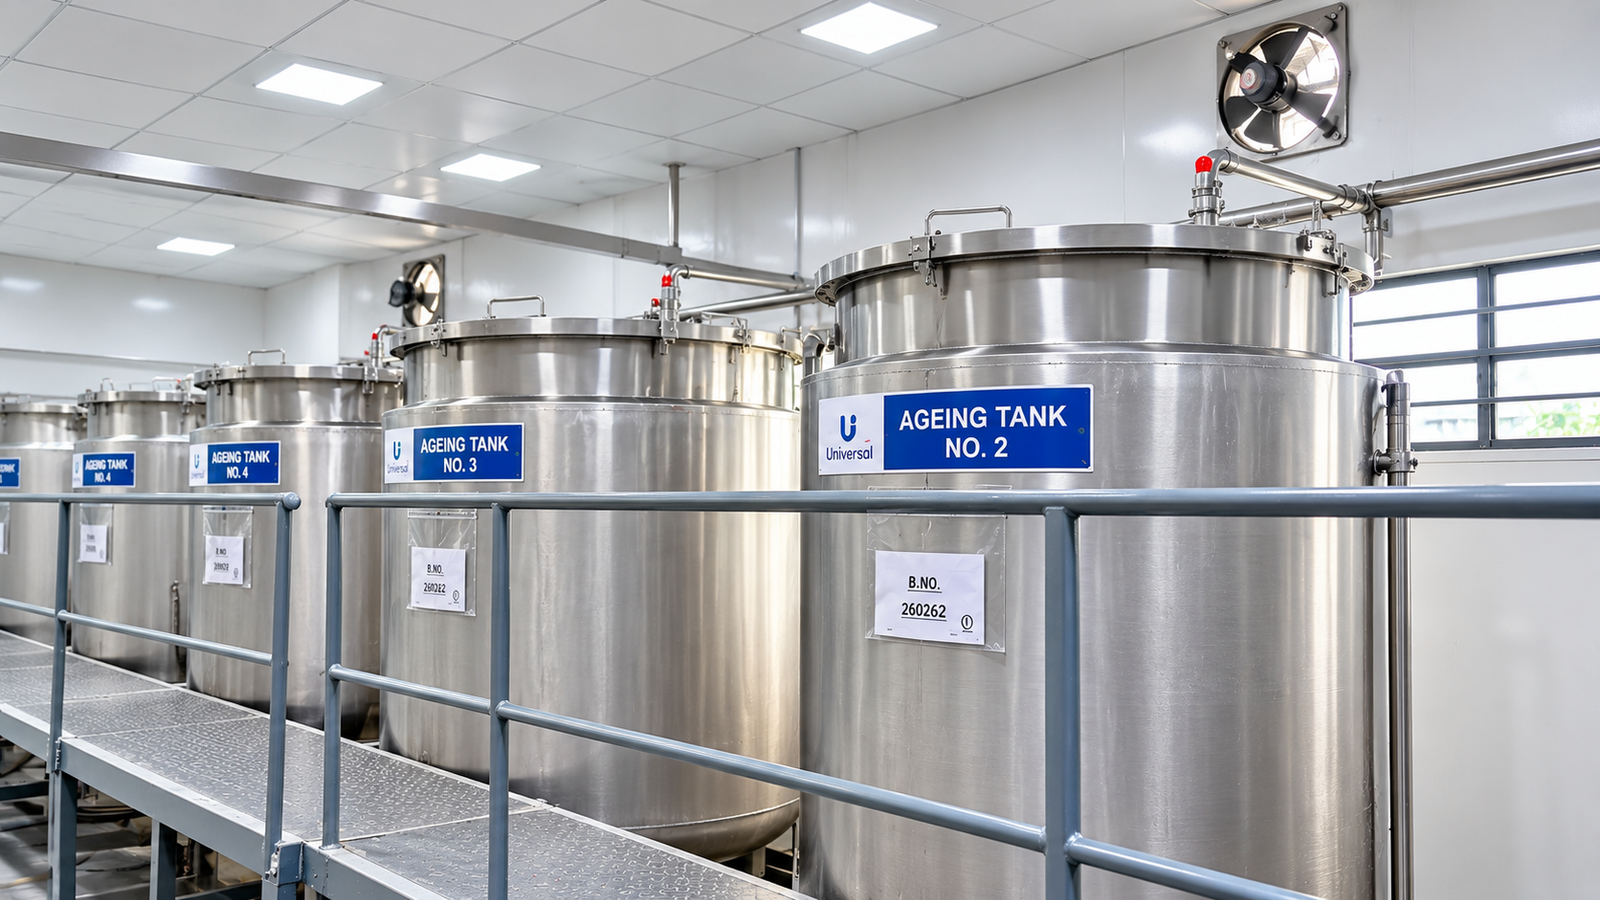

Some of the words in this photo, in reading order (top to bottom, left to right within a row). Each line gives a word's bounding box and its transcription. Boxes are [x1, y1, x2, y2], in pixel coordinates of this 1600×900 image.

[899, 406, 987, 431] AGEING
[995, 405, 1067, 428] TANK
[420, 437, 466, 453] AGEING
[469, 436, 509, 452] TANK
[945, 437, 986, 458] NO.
[994, 436, 1008, 458] 2
[211, 451, 242, 464] AGEING
[243, 450, 270, 463] TANK
[826, 445, 873, 461] Universal
[107, 459, 128, 470] TANK
[226, 466, 241, 479] NO.
[242, 466, 249, 479] 4
[443, 457, 466, 473] NO.
[469, 457, 477, 472] 3
[908, 575, 941, 590] B.NO.
[901, 602, 947, 618] 260262
